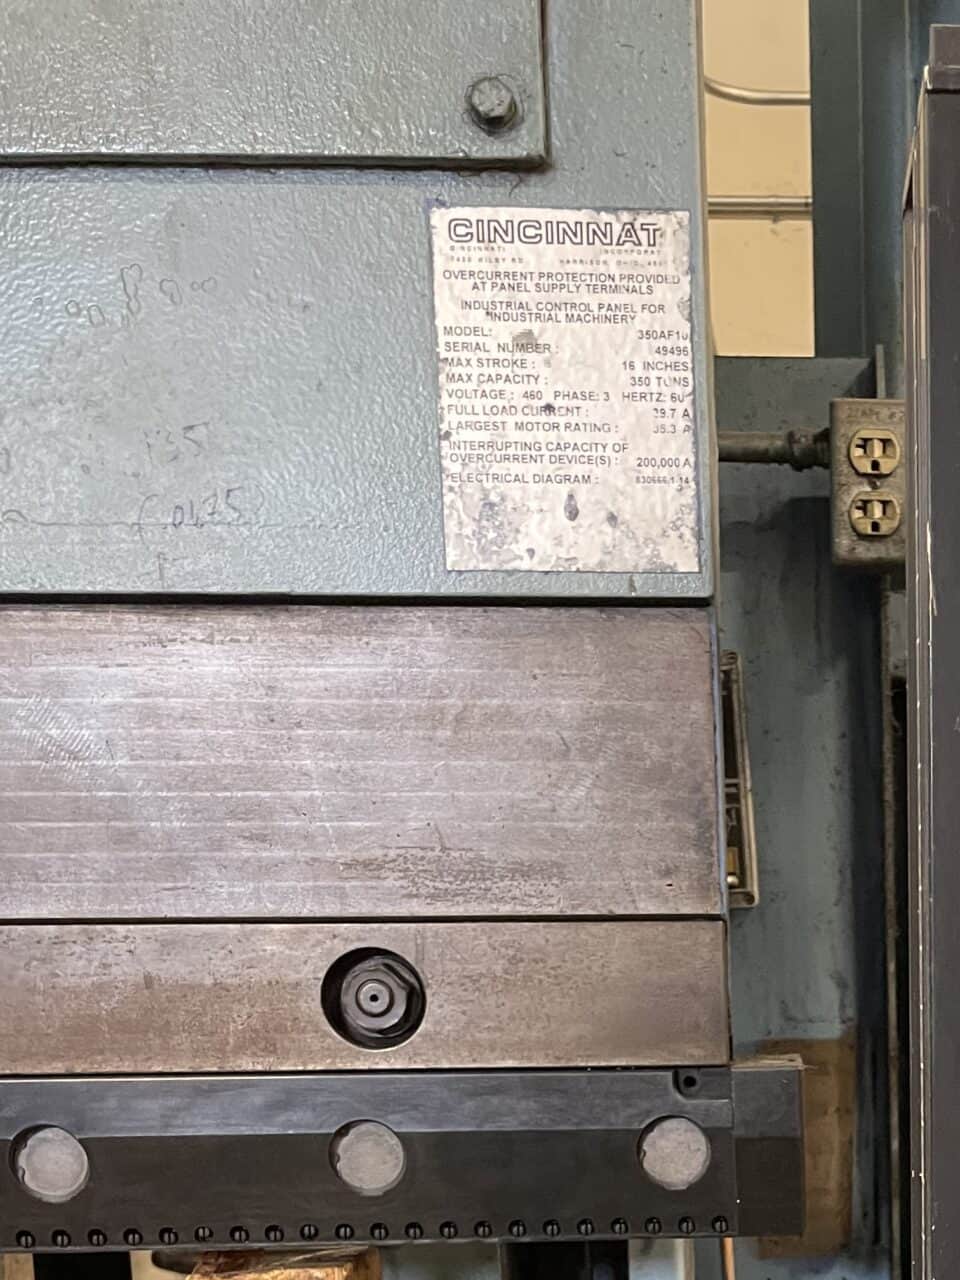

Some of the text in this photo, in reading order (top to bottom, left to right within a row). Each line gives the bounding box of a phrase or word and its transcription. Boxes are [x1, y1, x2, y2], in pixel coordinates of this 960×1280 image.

[443, 271, 680, 285] OVERCURRENT PROTECTION PROVIDED
[472, 282, 653, 295] AT PANEL SUPPLY TERMINALS
[461, 301, 665, 314] INDUSTRIAL CONTROL PANEL FOR
[490, 312, 636, 324] INDUSTRIAL MACHINERY
[444, 327, 492, 336] MODEL:
[444, 342, 490, 352] SERIAL
[447, 358, 473, 368] MAX
[622, 361, 635, 371] 16
[643, 362, 689, 371] INCHES
[446, 374, 475, 384] MAX
[630, 377, 650, 387] 350
[522, 391, 543, 400] 460
[448, 405, 479, 415] FULL
[483, 406, 517, 416] LOAD
[449, 421, 507, 431] LARGEST
[515, 422, 560, 432] MOTOR
[449, 441, 628, 453] INTERRUPTING CAPACITY OF
[450, 453, 545, 464] OVERCURRENT
[637, 457, 680, 468] 200,000
[450, 474, 529, 483] ELECTRICAL
